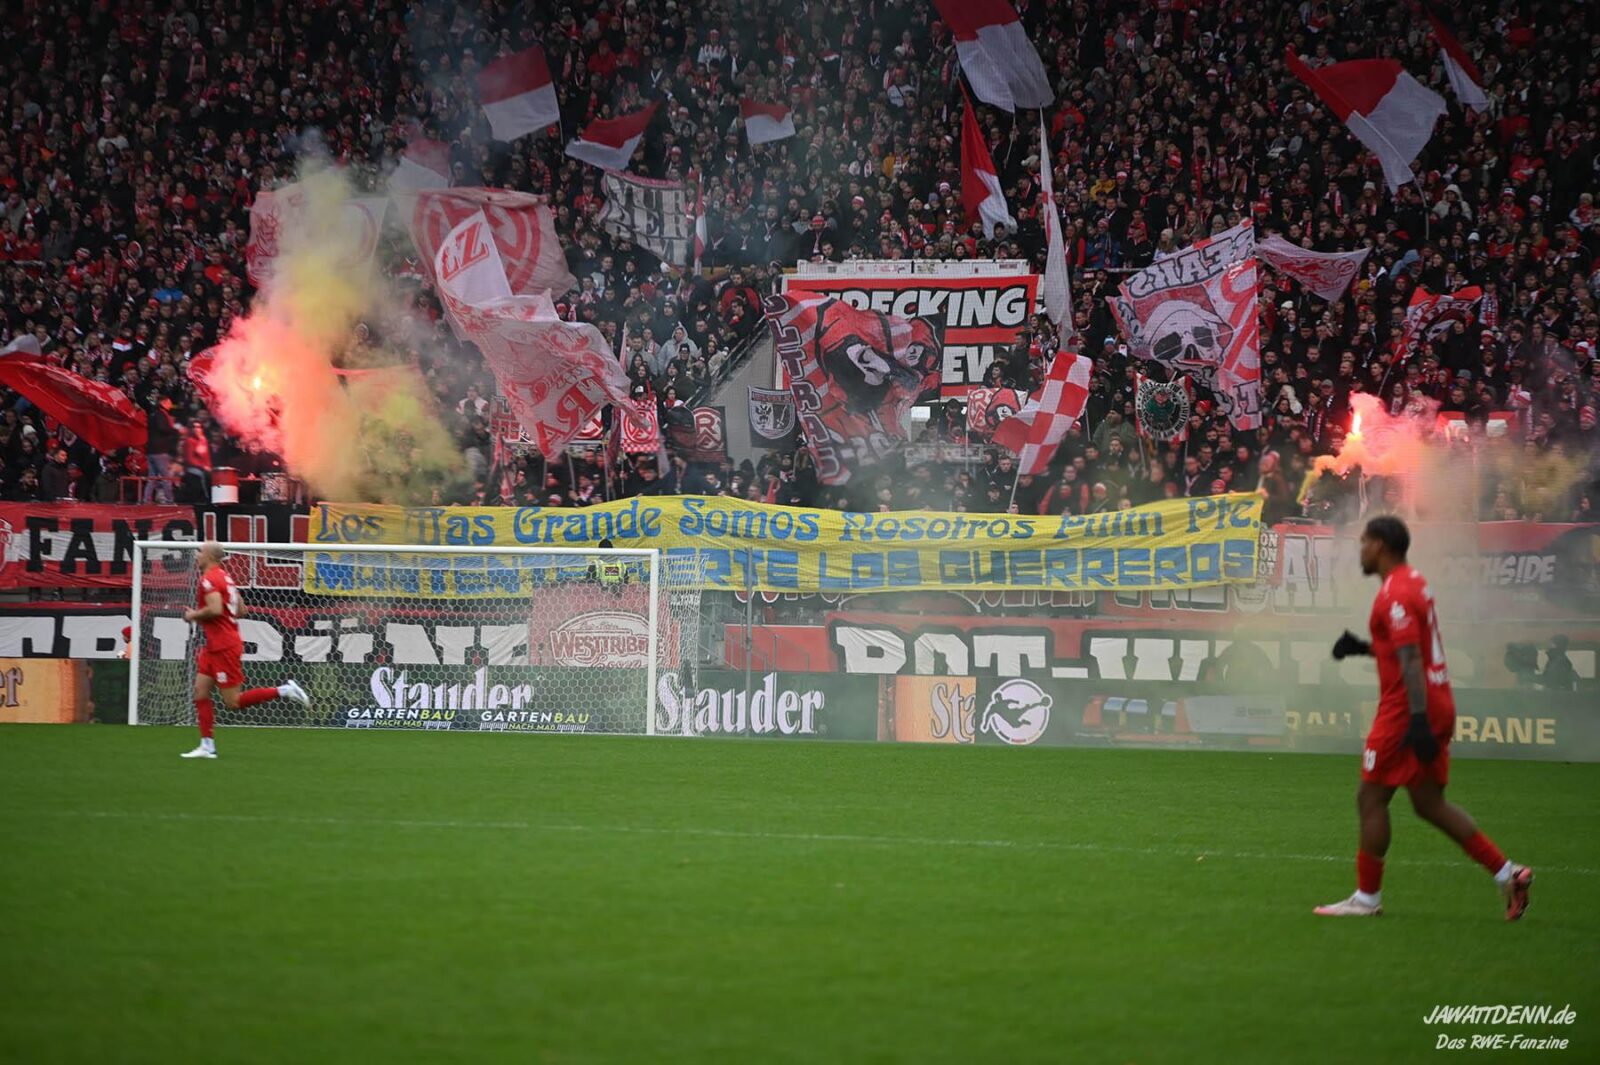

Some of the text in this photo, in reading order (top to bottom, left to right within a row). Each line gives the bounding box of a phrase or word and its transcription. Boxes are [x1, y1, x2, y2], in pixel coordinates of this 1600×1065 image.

[812, 288, 1028, 327] RECKING
[317, 503, 385, 542] Los
[514, 500, 663, 545] Grande
[679, 497, 820, 542] Somos
[26, 515, 195, 574] FANS
[819, 551, 920, 589] LOS
[938, 539, 1256, 587] GUERREROS
[551, 630, 667, 660] WESTTRIBÜE
[370, 666, 535, 710] Stauder
[656, 671, 826, 736] Stauder
[348, 708, 457, 721] GARTENBAU
[481, 710, 589, 724] GARTENBAU
[1453, 714, 1556, 745] RANE
